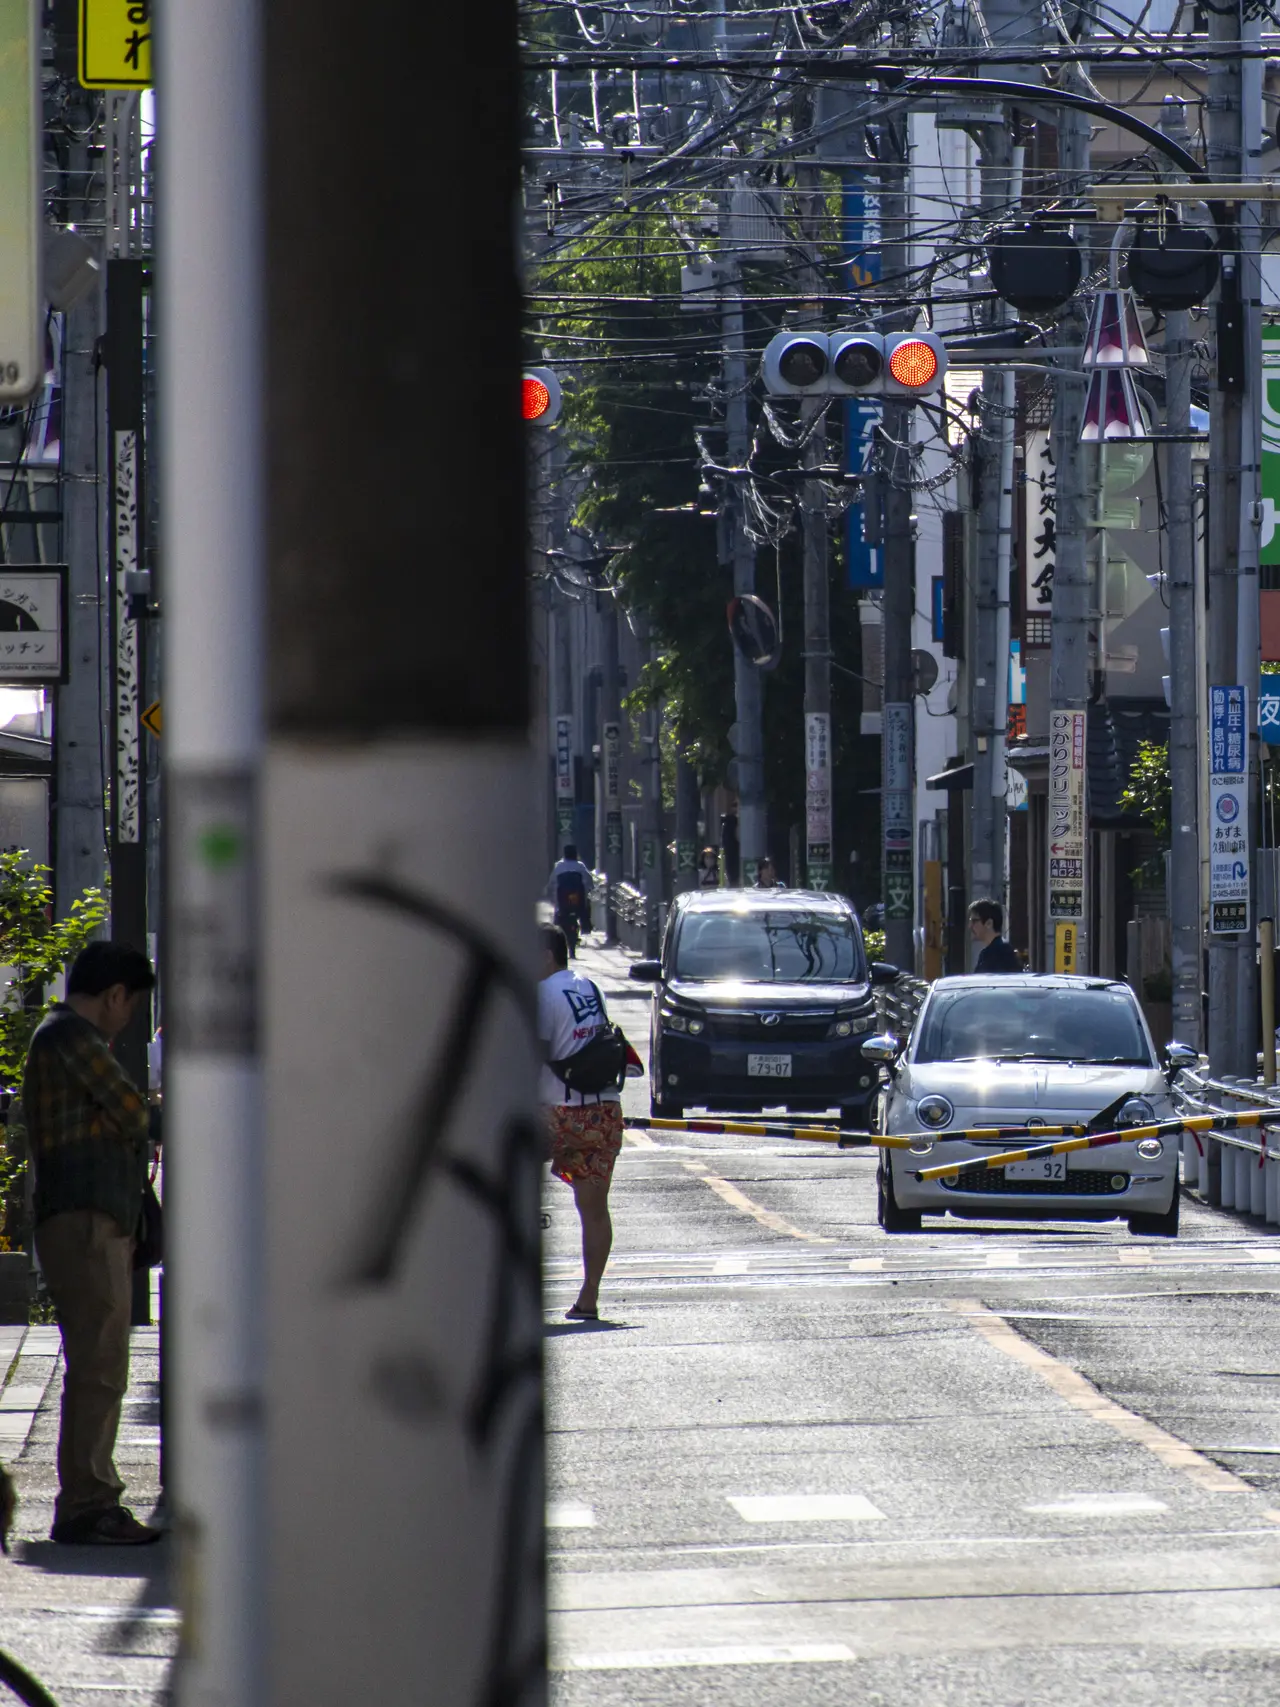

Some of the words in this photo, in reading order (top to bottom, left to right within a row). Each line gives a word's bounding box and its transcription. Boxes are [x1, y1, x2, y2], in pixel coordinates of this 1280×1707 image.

[1052, 715, 1070, 837] ひかりクリニック
[1215, 825, 1242, 839] あずま
